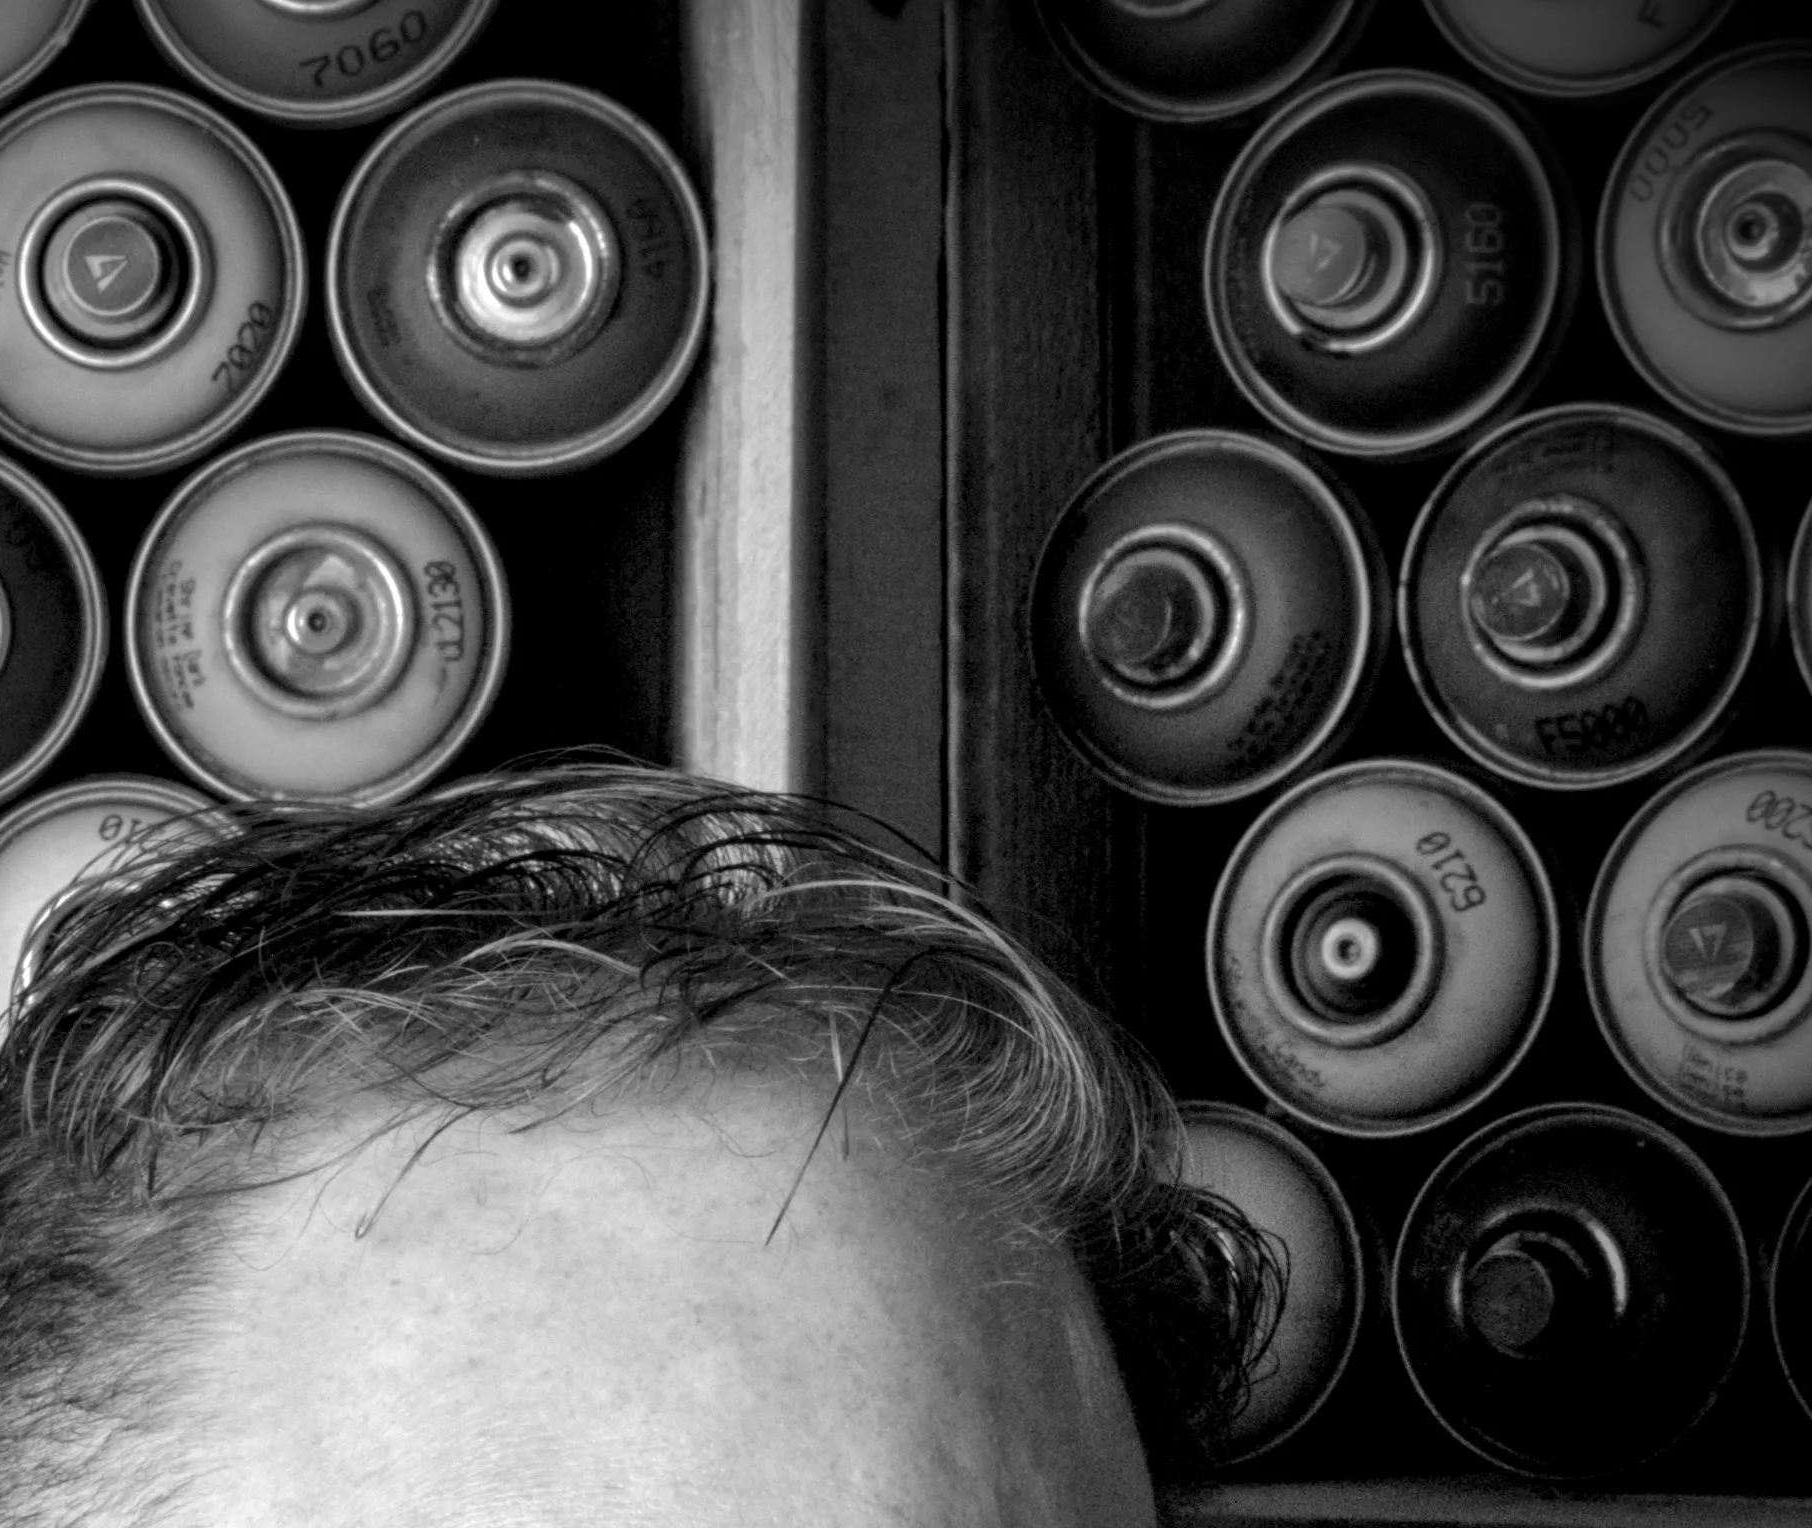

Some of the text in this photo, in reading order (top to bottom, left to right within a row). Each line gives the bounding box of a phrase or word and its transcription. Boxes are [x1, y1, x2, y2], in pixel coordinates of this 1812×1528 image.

[298, 9, 428, 89] 7060
[1465, 201, 1505, 306] 5160
[1415, 831, 1487, 912] 6210
